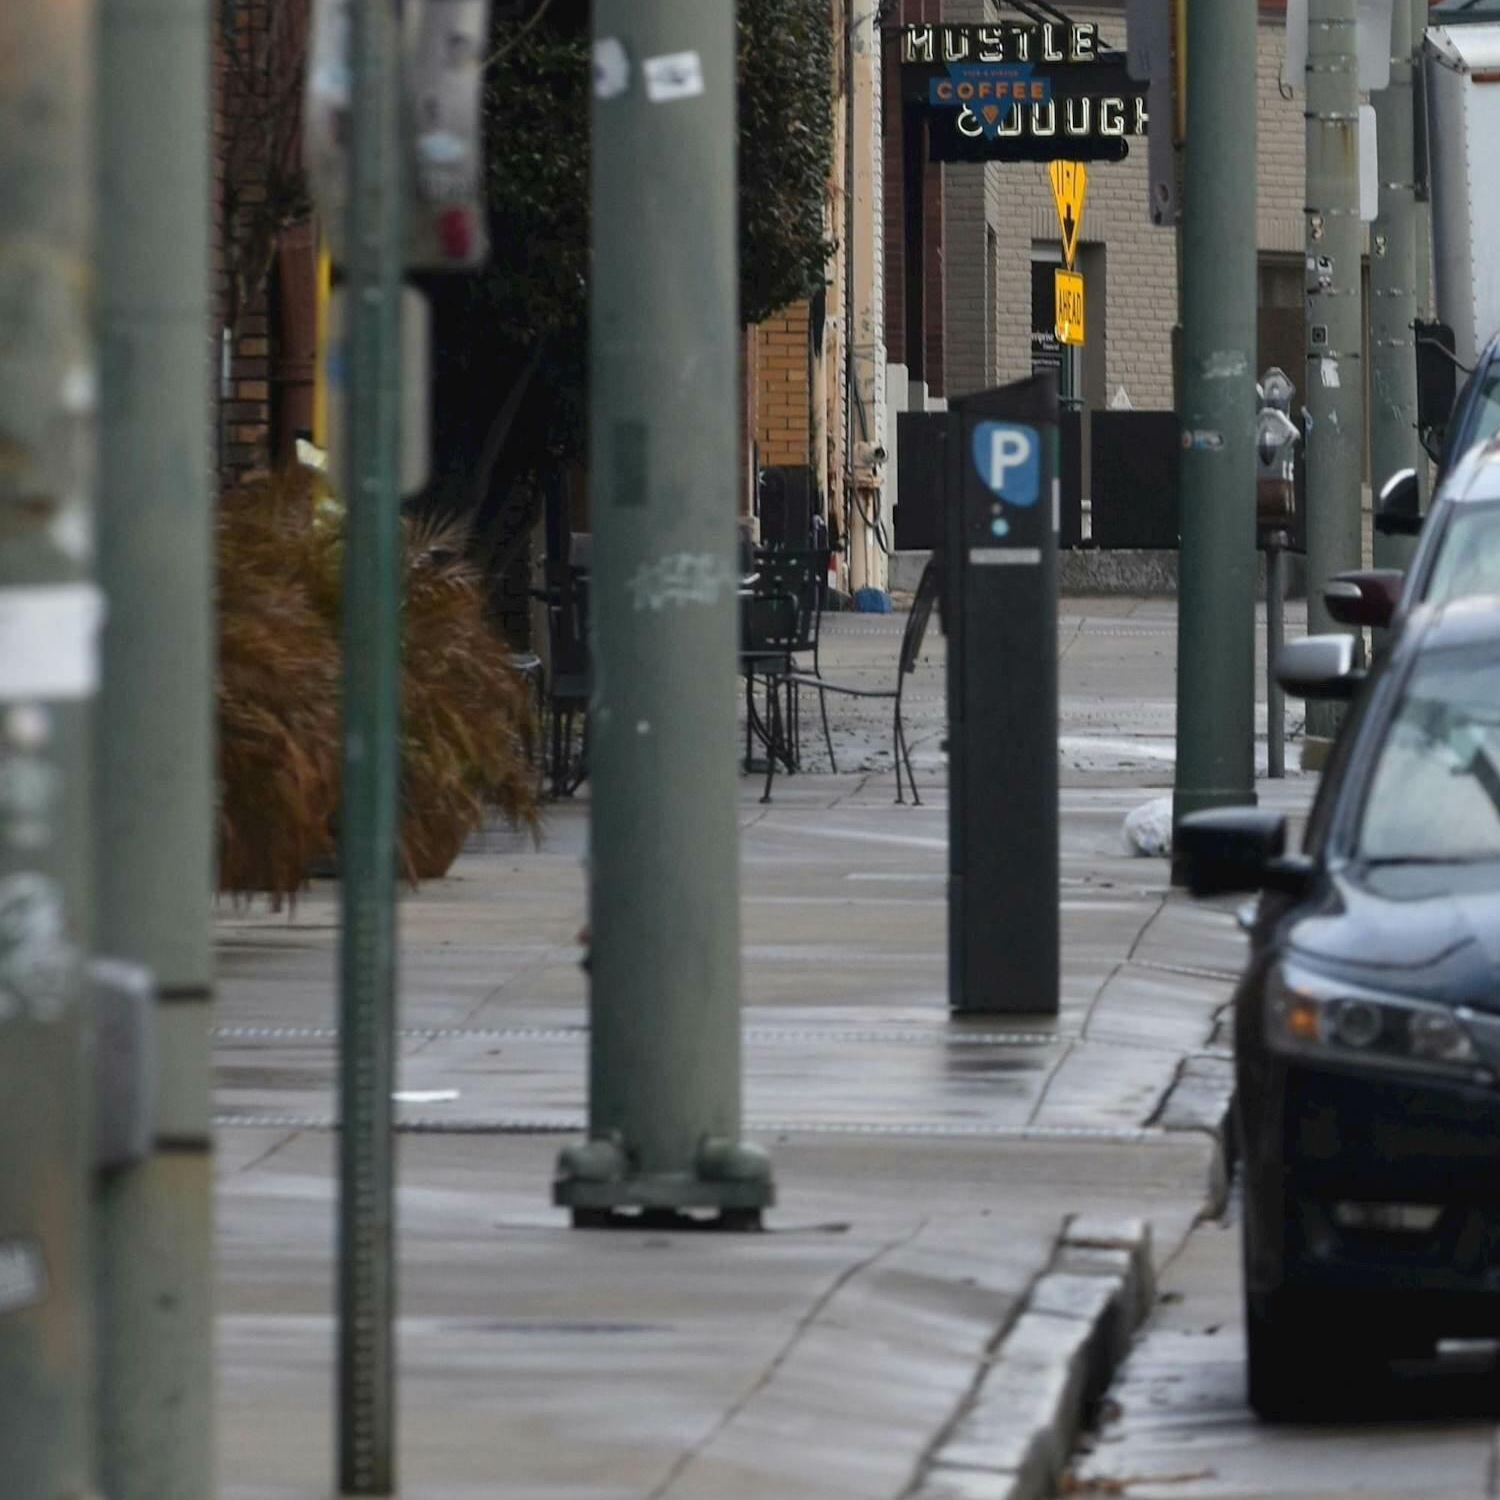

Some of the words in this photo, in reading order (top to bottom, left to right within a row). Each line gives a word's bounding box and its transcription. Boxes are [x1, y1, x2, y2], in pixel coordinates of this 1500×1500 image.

[905, 22, 1097, 63] HUSTLE
[936, 81, 1045, 99] COFFEE
[1058, 289, 1082, 326] AHEAD
[989, 431, 1030, 490] P
